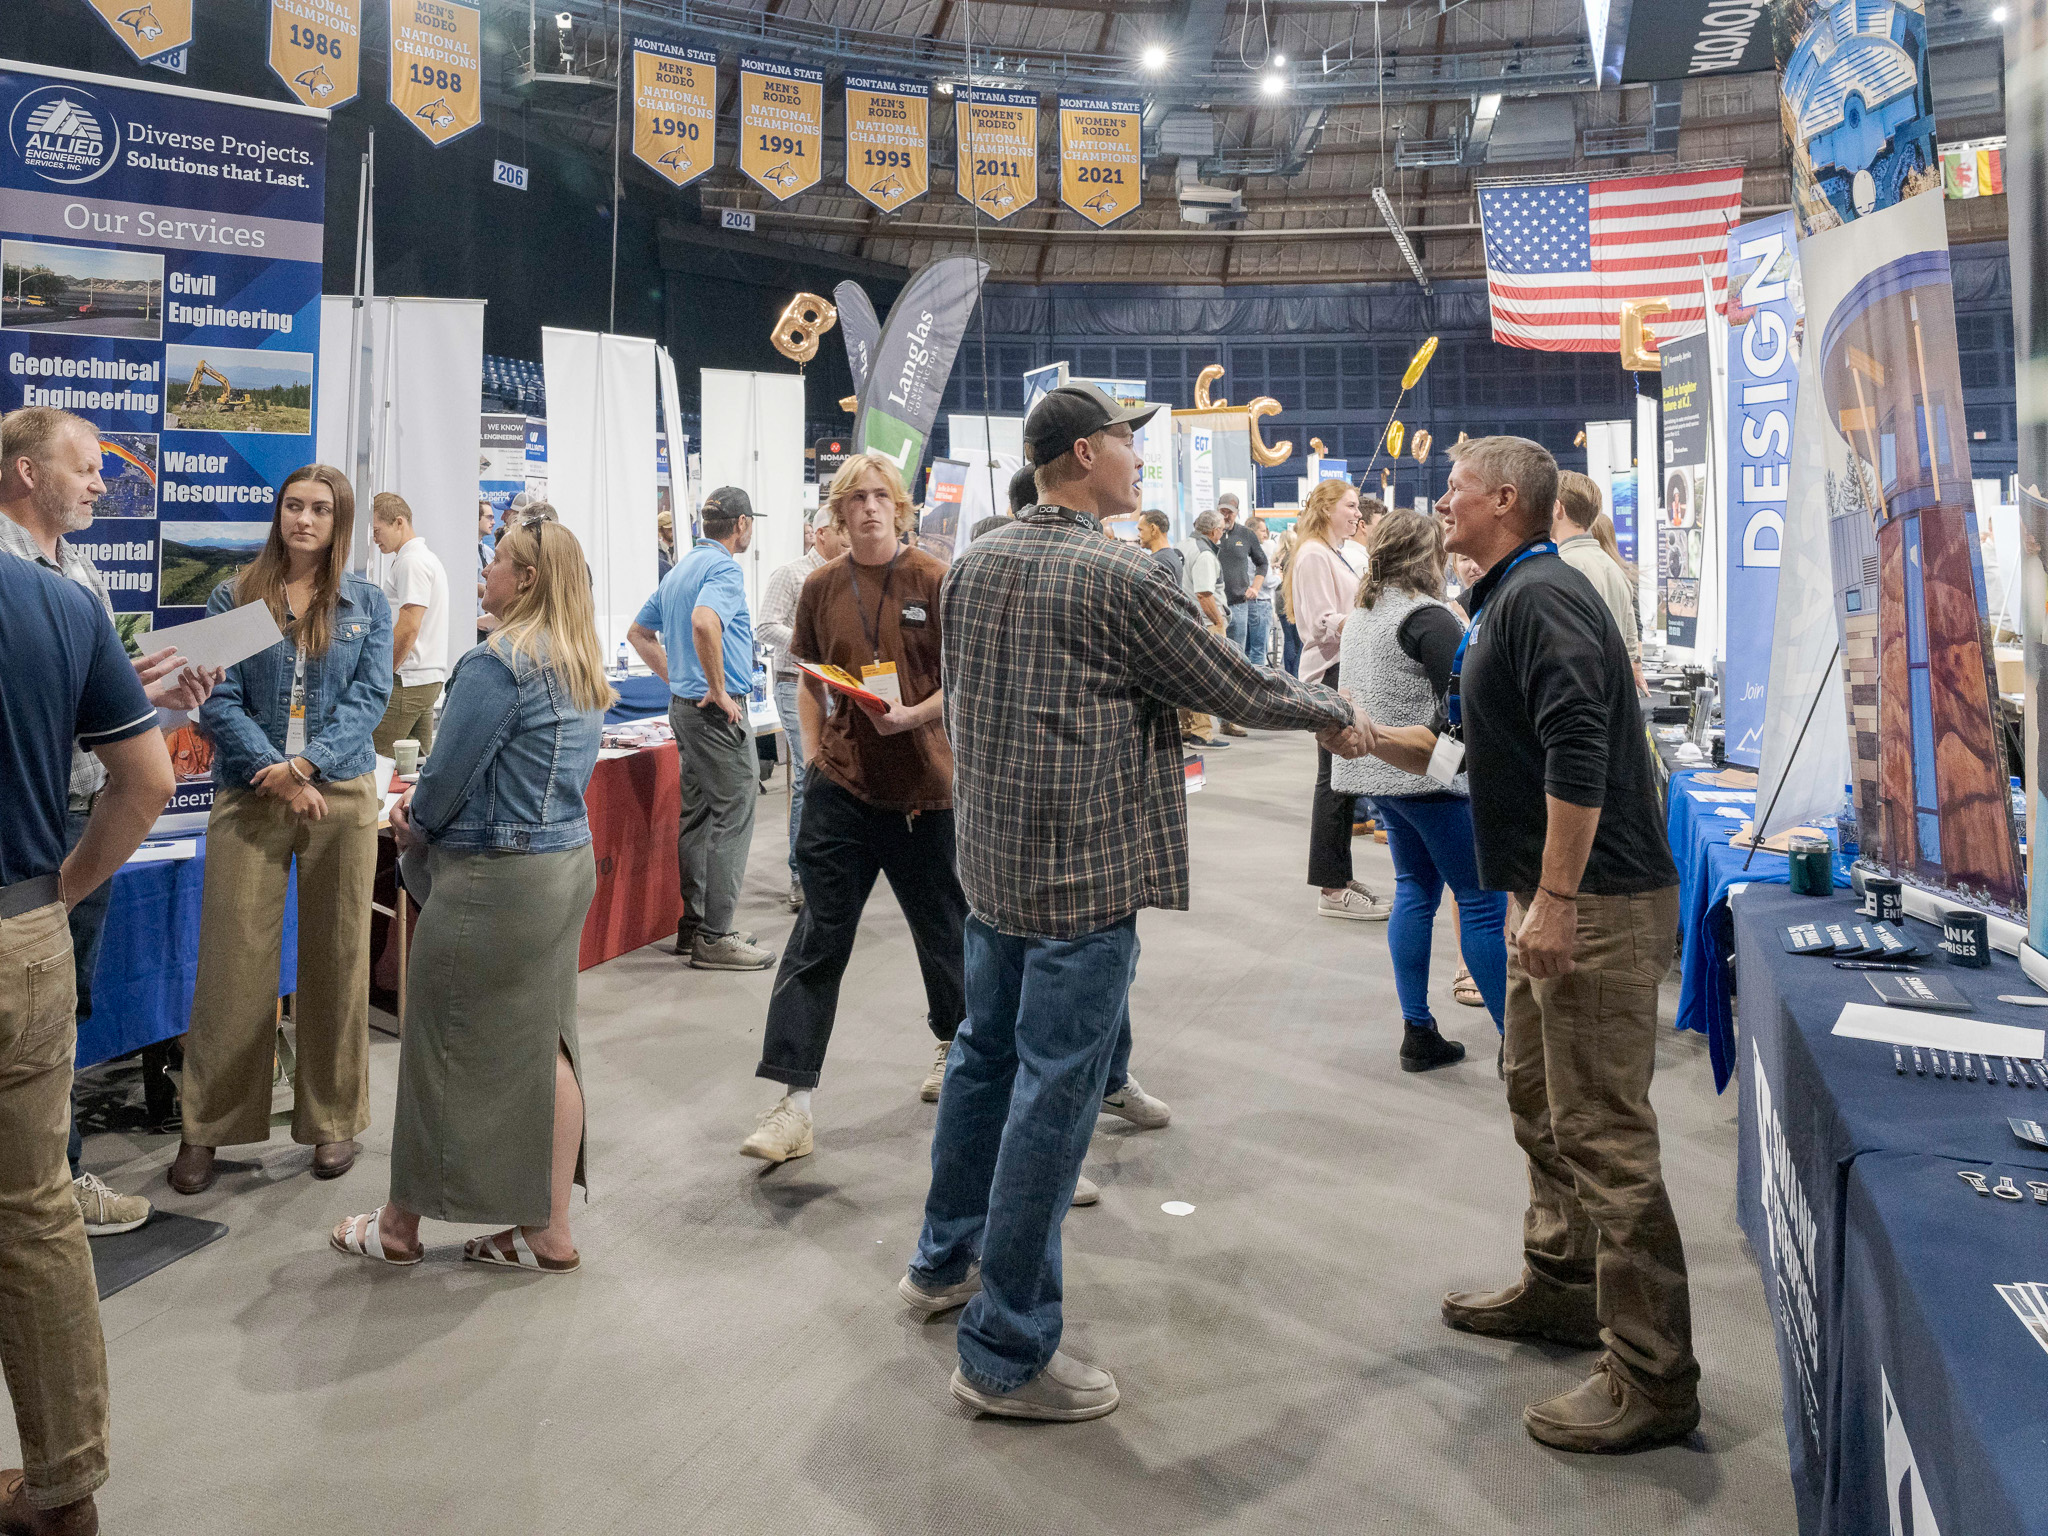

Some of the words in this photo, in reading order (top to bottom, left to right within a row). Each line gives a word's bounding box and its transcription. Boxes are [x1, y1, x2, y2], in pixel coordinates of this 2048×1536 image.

[274, 0, 357, 37] CHAMPIONS
[417, 1, 454, 20] MEN'S
[414, 12, 457, 33] RODEO
[289, 23, 342, 60] 1986
[401, 26, 471, 55] NATIONAL
[634, 37, 685, 57] MONTANA
[687, 49, 716, 63] STATE
[395, 39, 477, 70] CHAMPIONS
[410, 63, 462, 93] 1988
[658, 61, 693, 77] MEN'S
[741, 59, 791, 76] MONTANA
[793, 68, 823, 81] STATE
[656, 72, 695, 88] RODEO
[765, 81, 799, 95] MEN'S
[846, 76, 897, 91] MONTANA
[899, 83, 929, 94] STATE
[643, 85, 707, 107] NATIONAL
[762, 91, 801, 106] RODEO
[870, 97, 905, 110] MEN'S
[956, 90, 1007, 102] MONTANA
[1008, 94, 1037, 105] STATE
[1060, 98, 1109, 110] MONTANA
[1111, 102, 1140, 112] STATE
[637, 97, 714, 120] CHAMPIONS
[751, 104, 814, 124] NATIONAL
[868, 108, 907, 119] RODEO
[971, 108, 1023, 121] WOMEN'S
[652, 117, 699, 141] 1990
[744, 115, 820, 136] CHAMPIONS
[856, 120, 919, 136] NATIONAL
[978, 119, 1016, 130] RODEO
[1074, 116, 1127, 128] WOMEN'S
[1082, 127, 1120, 137] RODEO
[25, 133, 104, 157] ALLIED
[127, 121, 216, 152] Diverse
[220, 135, 315, 166] Projects.
[759, 134, 805, 157] 1991
[849, 131, 925, 149] CHAMPIONS
[966, 132, 1028, 146] NATIONAL
[1069, 140, 1132, 152] NATIONAL
[25, 148, 101, 166] ENGINEERING
[864, 149, 911, 169] 1995
[960, 143, 1034, 157] CHAMPIONS
[1063, 150, 1137, 164] CHAMPIONS
[25, 158, 66, 170] SERVICES,
[67, 163, 82, 171] INC.
[126, 151, 219, 177] Solutions
[221, 165, 262, 182] that
[265, 168, 310, 189] Last.
[976, 159, 1020, 178] 2011
[498, 165, 524, 187] 206
[1078, 166, 1124, 184] 2021
[63, 203, 129, 235] Our
[136, 211, 267, 249] Services
[726, 211, 752, 229] 204
[169, 272, 216, 297] Civil
[169, 301, 294, 334] Engineering
[10, 352, 161, 382] Geotechnical
[888, 310, 934, 410] Langlas
[913, 345, 939, 416] CONTRACTORS
[23, 384, 160, 414] Engineering
[907, 369, 924, 414] GENERAL
[1740, 229, 1789, 569] DESIGN
[484, 433, 524, 441] ENGINEERING
[487, 423, 500, 431] WE
[501, 424, 524, 432] KNOW
[1194, 435, 1210, 452] EGT
[163, 451, 229, 474] Water
[162, 481, 275, 504] Resources
[1740, 681, 1765, 701] Join
